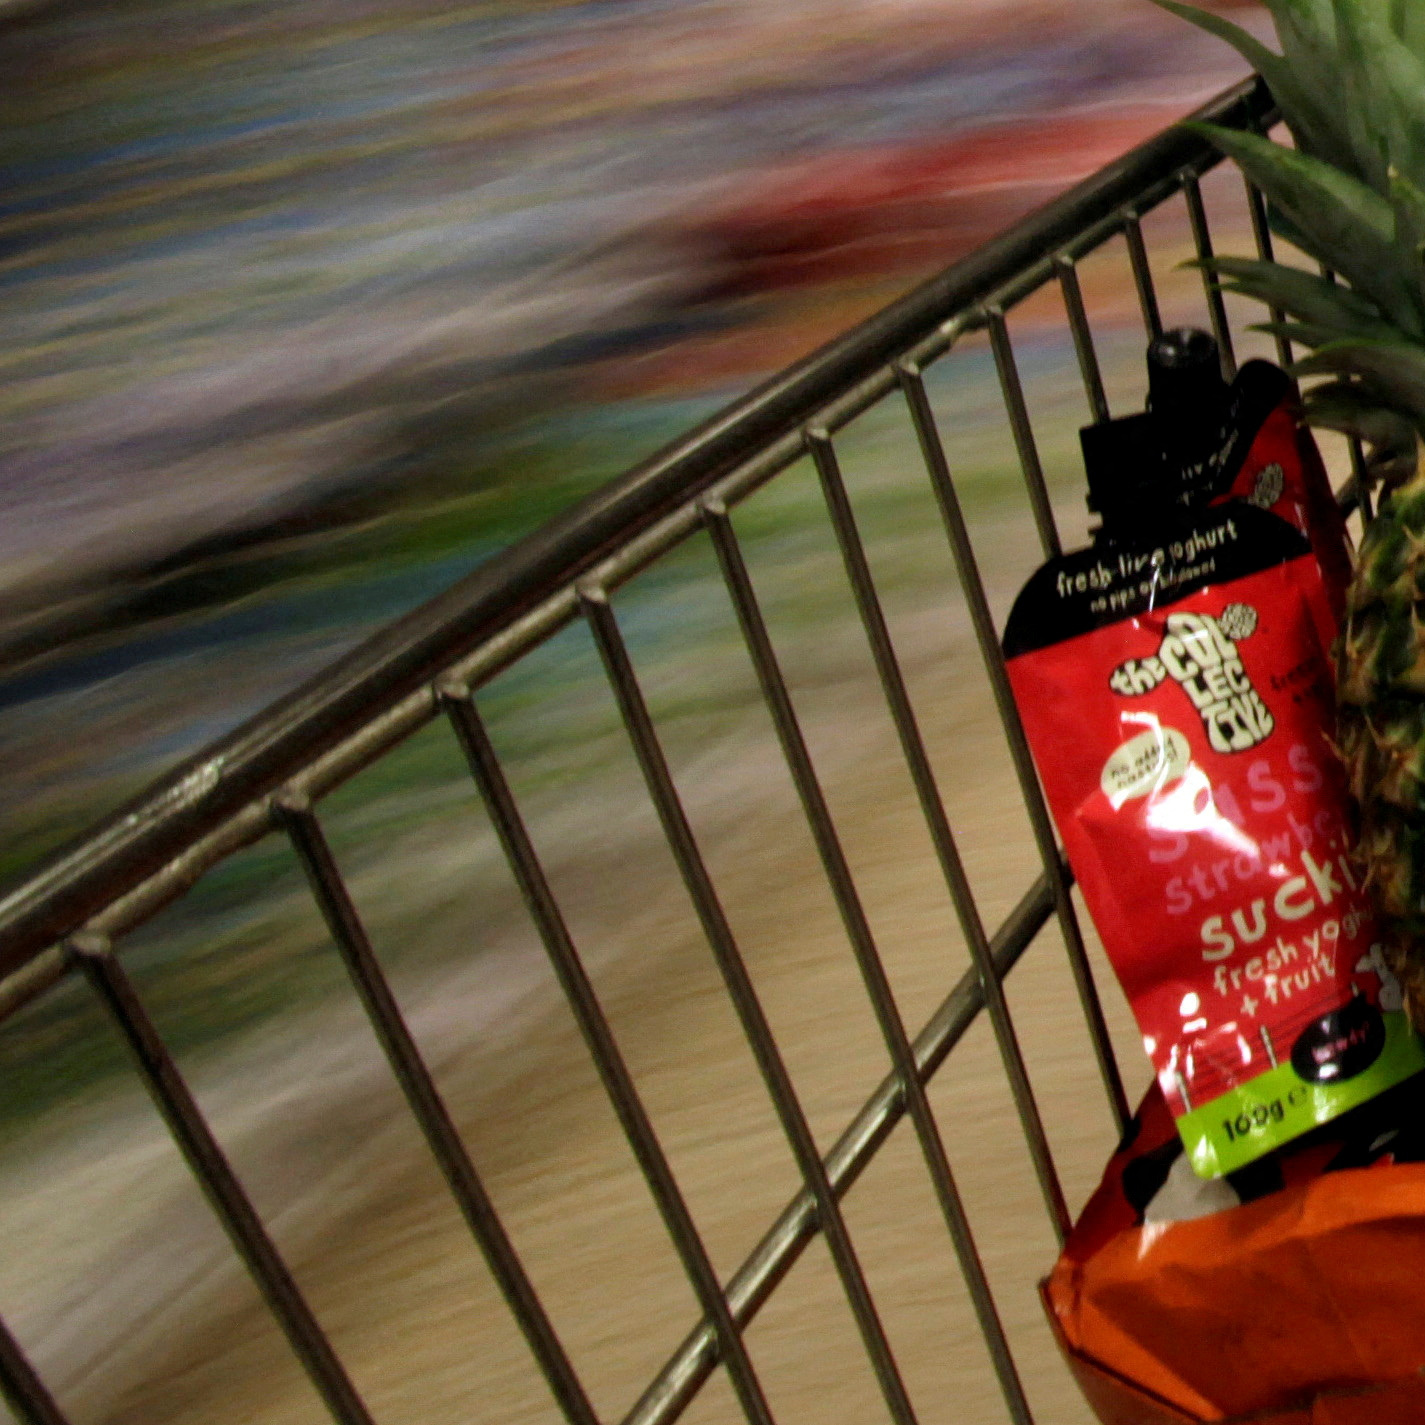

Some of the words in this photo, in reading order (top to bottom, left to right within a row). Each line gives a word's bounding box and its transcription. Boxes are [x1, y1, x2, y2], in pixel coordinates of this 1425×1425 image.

[1110, 655, 1167, 696] the
[1213, 936, 1299, 997] fresh
[1263, 953, 1336, 1005] fruit
[1222, 1098, 1285, 1143] 100g
